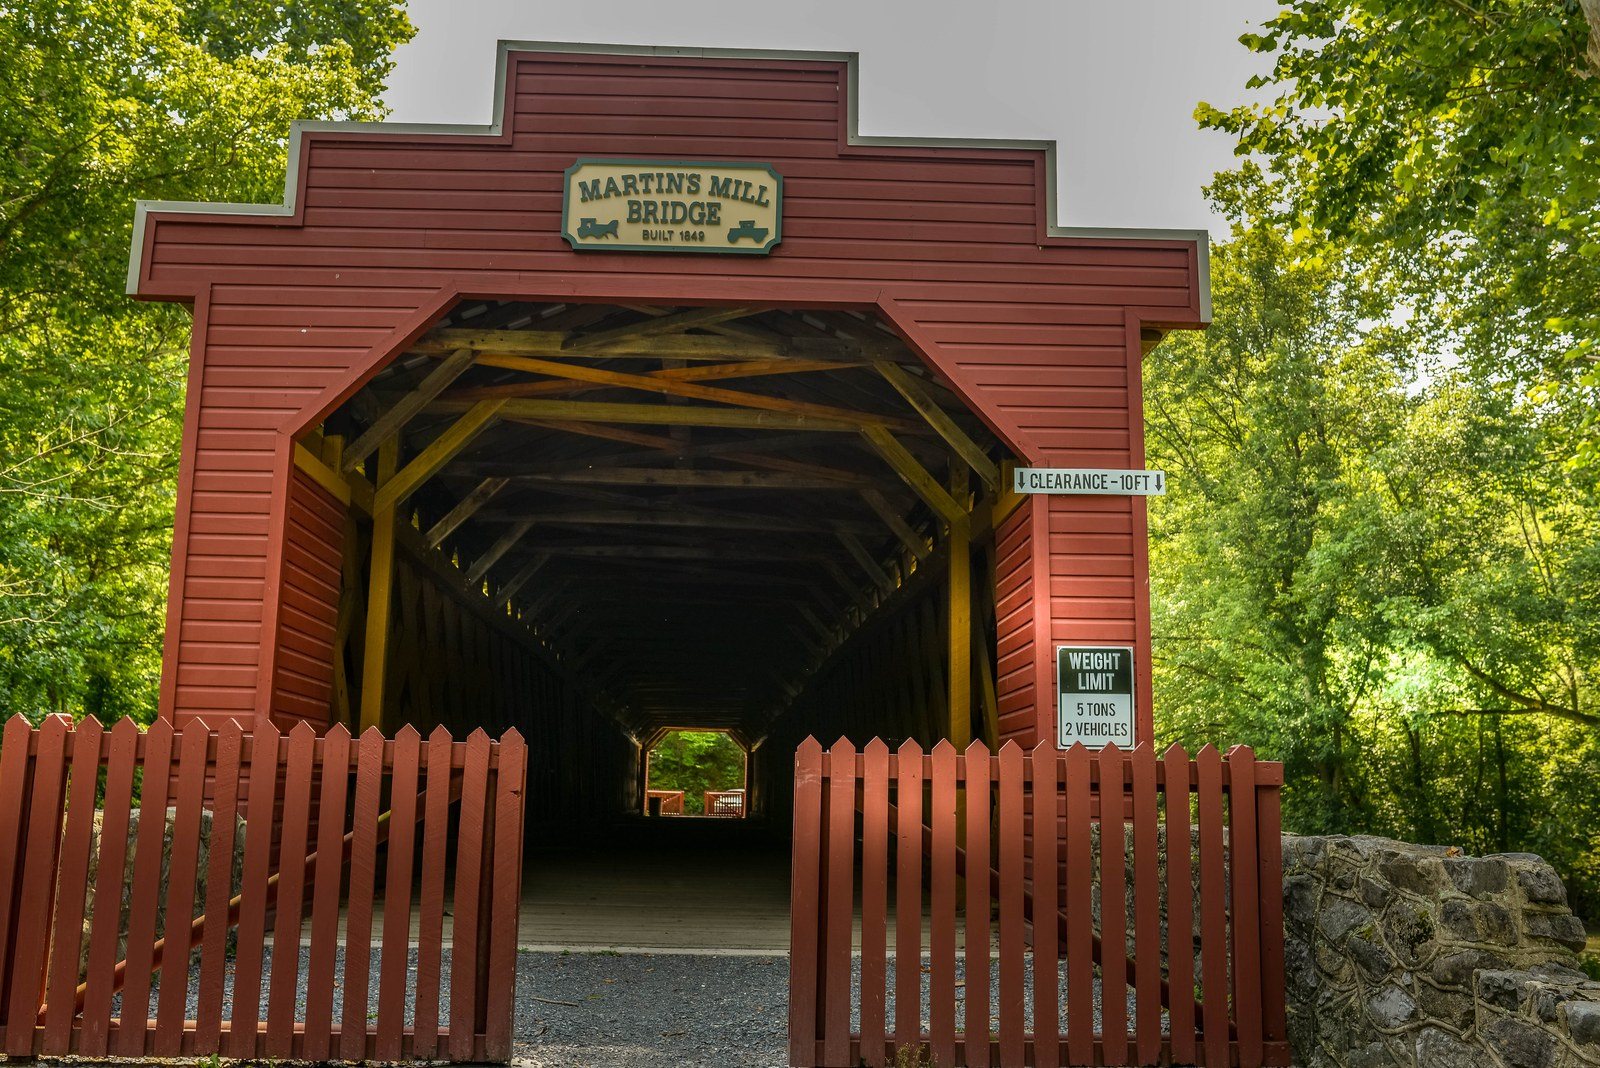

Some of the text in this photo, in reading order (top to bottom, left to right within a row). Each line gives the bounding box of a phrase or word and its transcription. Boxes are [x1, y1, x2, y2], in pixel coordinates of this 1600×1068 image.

[578, 173, 770, 208] MARTIN'S MILL
[626, 199, 722, 225] BRIDGE
[642, 229, 705, 242] BUILT 1849
[1068, 652, 1121, 670] WEIGHT
[1078, 672, 1115, 690] LIMIT
[1077, 702, 1116, 717] 5 TONS
[1065, 722, 1128, 736] 2 VEHICLES
